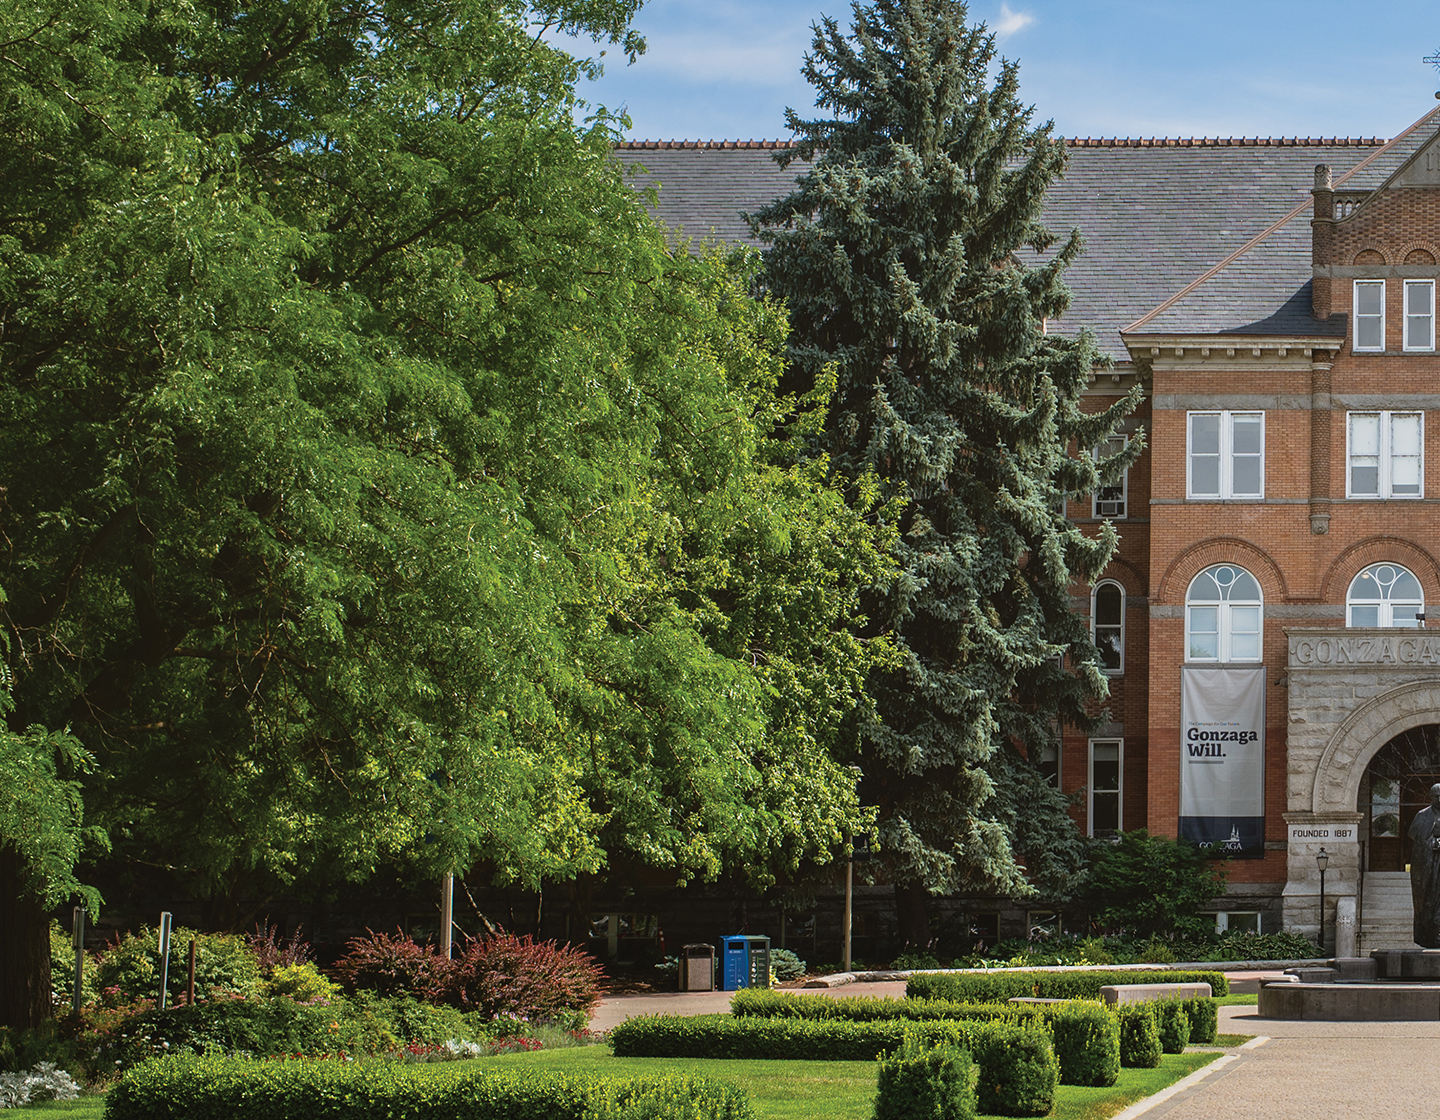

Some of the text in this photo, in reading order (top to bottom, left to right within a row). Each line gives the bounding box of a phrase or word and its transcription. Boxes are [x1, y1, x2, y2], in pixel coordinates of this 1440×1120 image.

[1296, 638, 1437, 664] GONZAGA
[1187, 728, 1259, 745] Gonzaga
[1187, 743, 1227, 757] Will.
[1292, 829, 1352, 838] FOUNDED 1887
